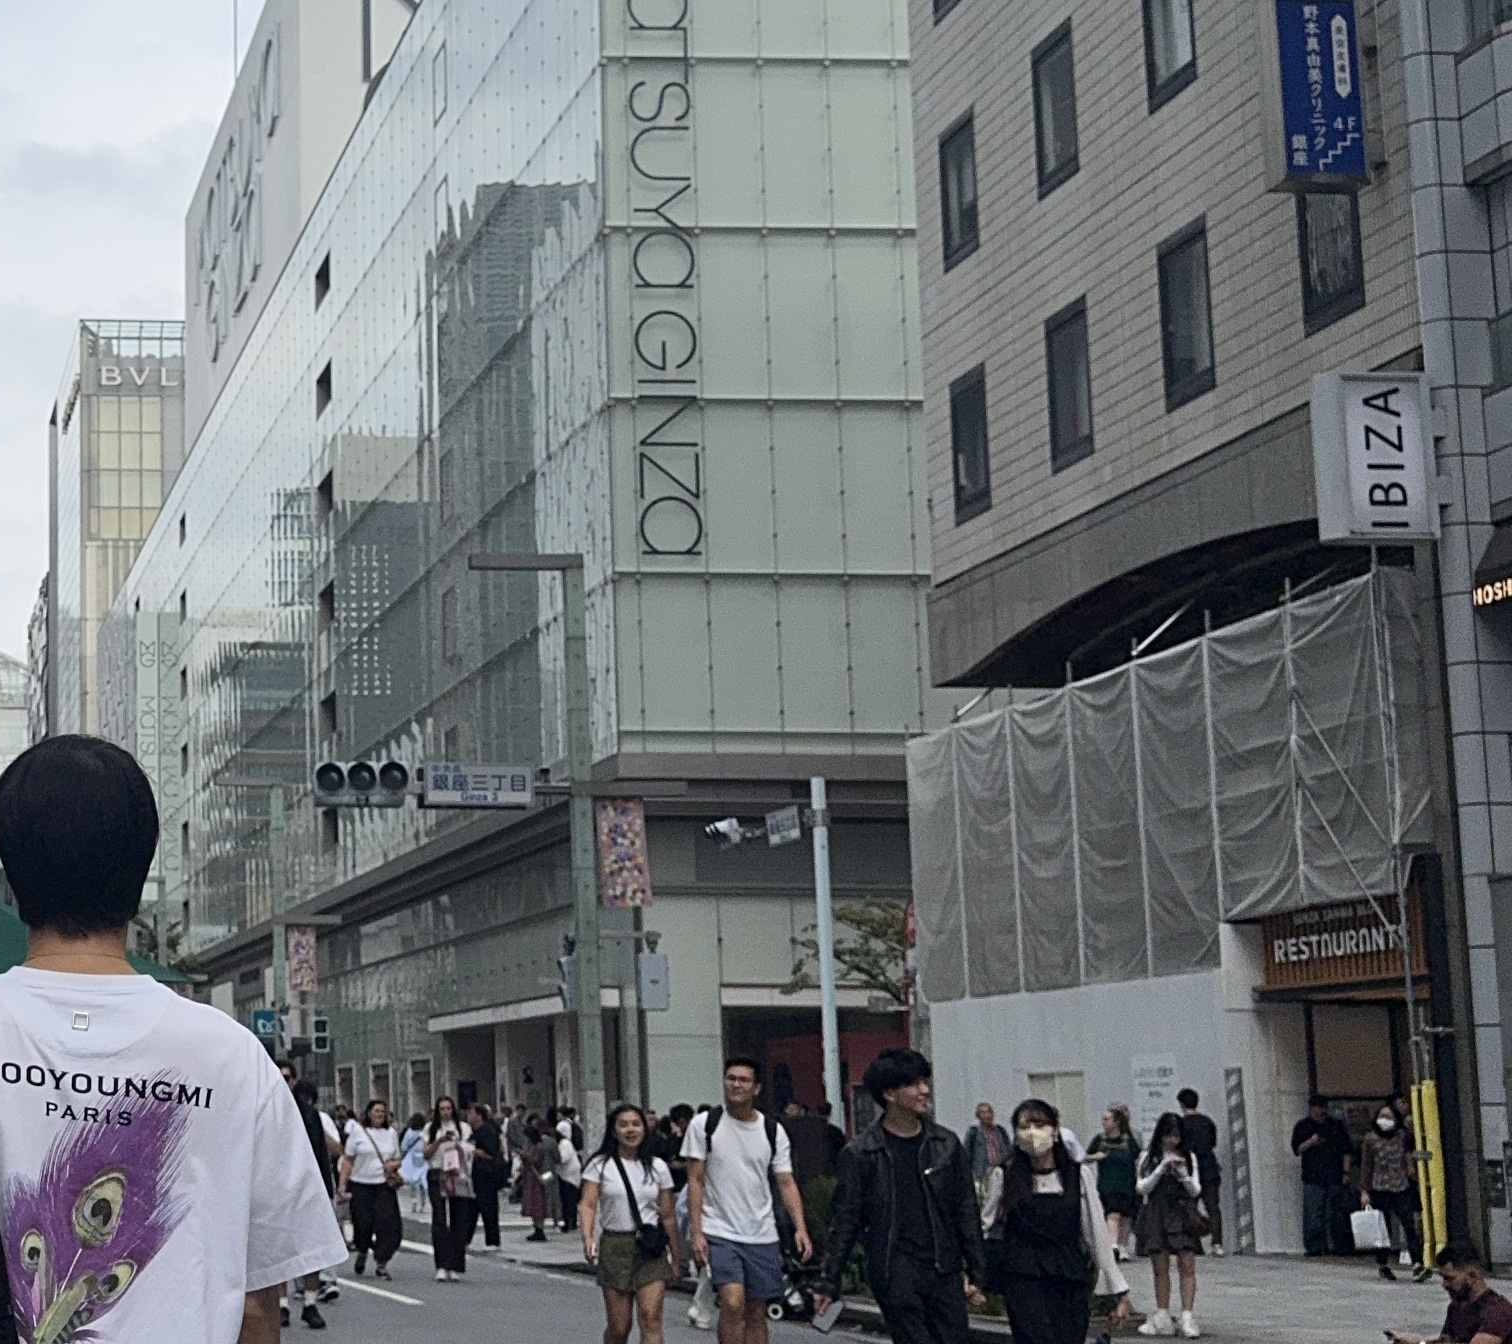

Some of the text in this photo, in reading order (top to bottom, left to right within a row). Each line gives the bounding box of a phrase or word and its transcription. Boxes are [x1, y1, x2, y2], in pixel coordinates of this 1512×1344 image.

[1361, 387, 1410, 529] IBIZA
[432, 774, 527, 792] 銀座三丁目
[461, 790, 488, 801] Ginza
[46, 1102, 133, 1127] PARIS
